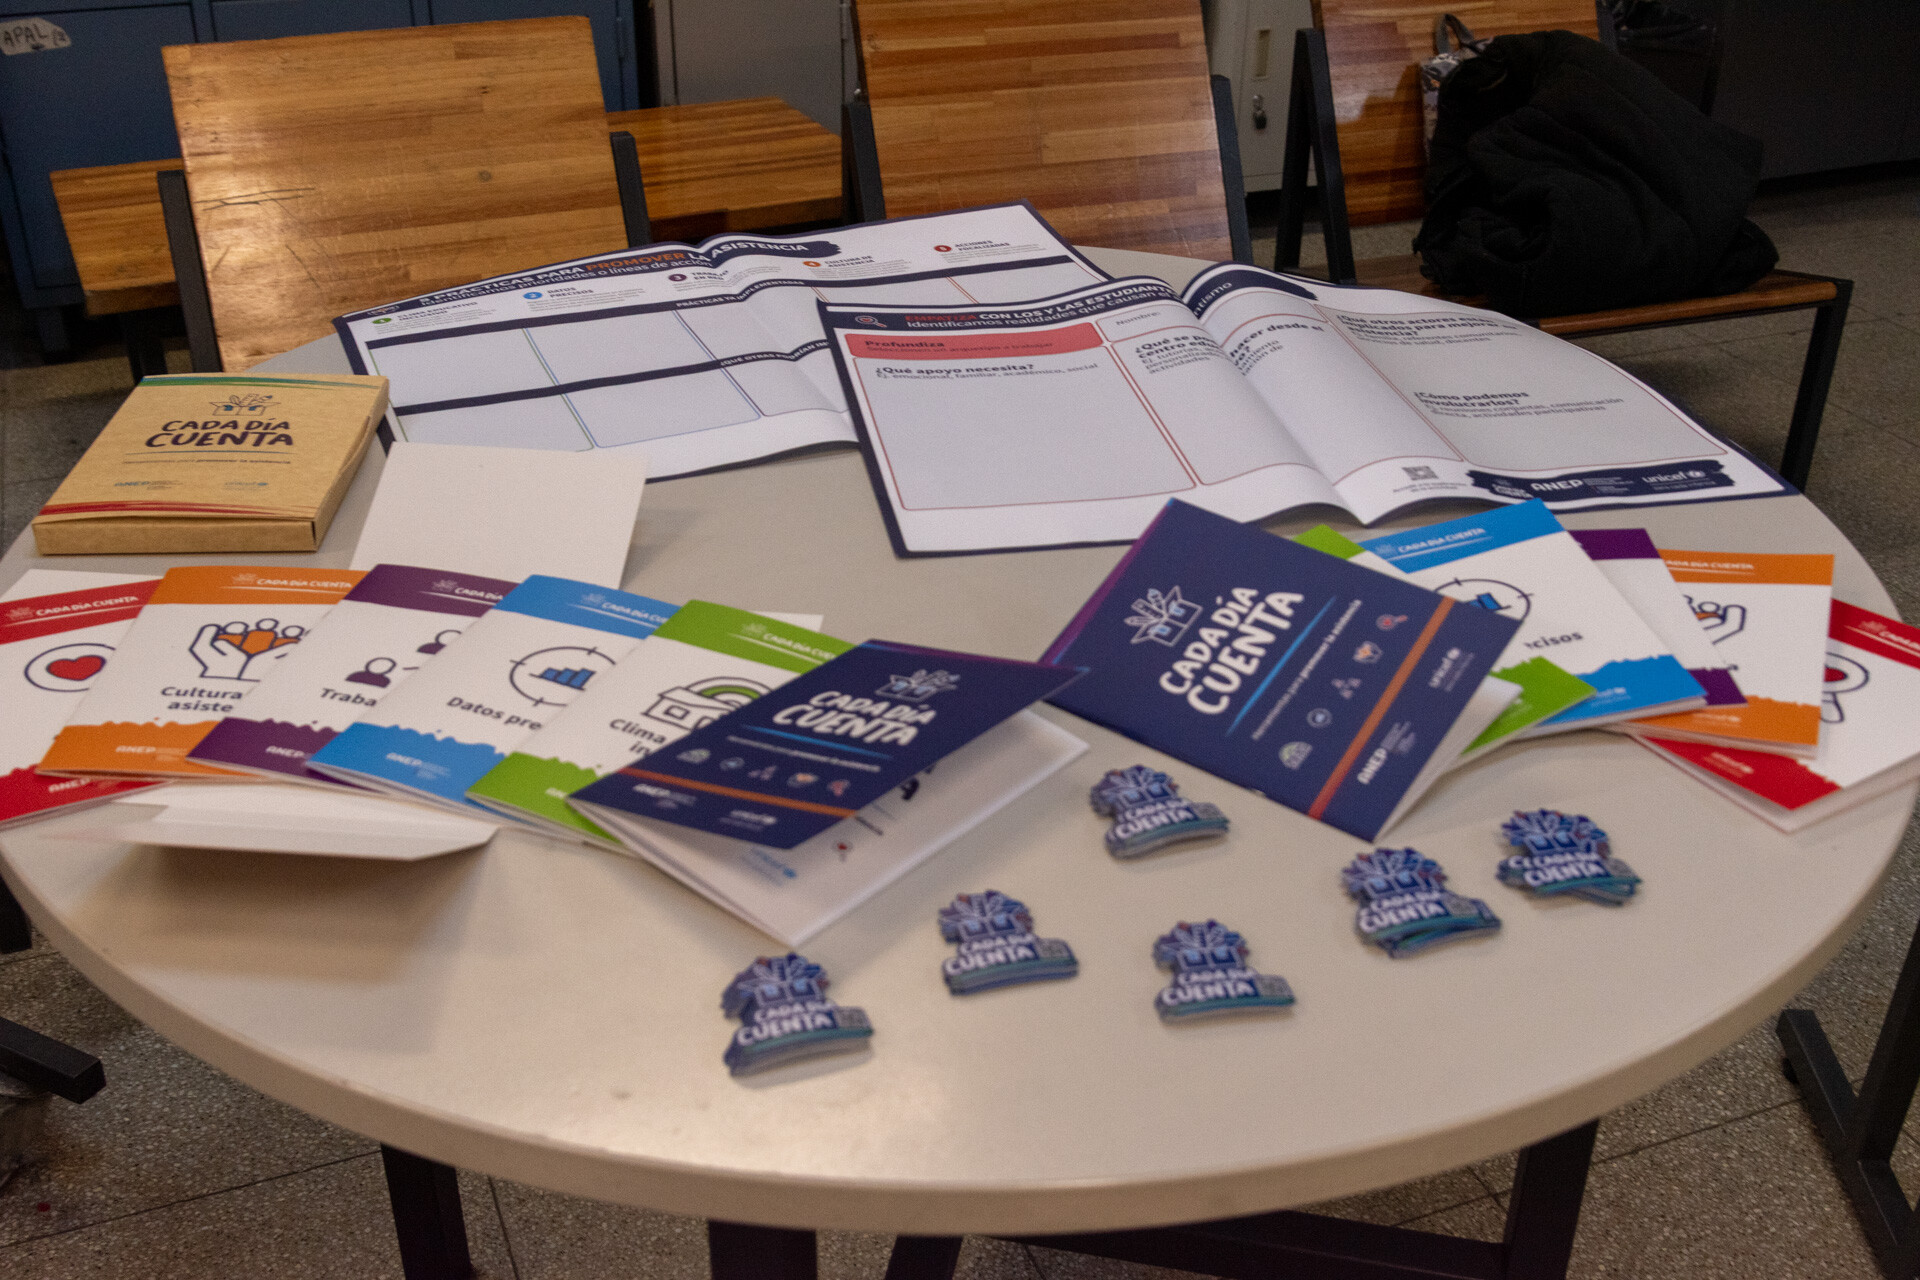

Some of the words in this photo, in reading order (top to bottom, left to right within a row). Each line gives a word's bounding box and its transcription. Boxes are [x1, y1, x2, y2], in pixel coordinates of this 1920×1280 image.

[537, 266, 586, 280] PARA
[586, 252, 686, 271] PROMOVER
[688, 252, 712, 263] LA
[712, 241, 809, 259] ASISTENCIA
[519, 271, 596, 289] prioridades
[609, 262, 649, 275] líneas
[651, 260, 668, 269] de
[905, 314, 978, 322] EMPATIZA
[979, 312, 1010, 320] CON
[1014, 307, 1044, 318] LOS
[1055, 302, 1086, 313] LAS
[907, 319, 1002, 329] Identificamos
[1007, 308, 1078, 325] realidades
[1079, 303, 1107, 315] que
[1108, 291, 1157, 307] causan
[1267, 322, 1309, 332] desde
[865, 340, 945, 348] Profundiza
[1173, 334, 1190, 342] se
[875, 366, 912, 376] ¿Qué
[916, 367, 963, 376] apoyo
[966, 363, 1035, 374] necesita?
[1066, 362, 1099, 373] social
[1461, 390, 1530, 401] podemos
[162, 420, 240, 432] CADA
[244, 418, 291, 431] DÍA
[145, 431, 294, 448] CUENTA
[1531, 479, 1584, 492] ANEP
[1642, 471, 1687, 484] unicef
[309, 580, 353, 588] CUENTA
[36, 605, 71, 617] CADA
[92, 596, 139, 608] CUENTA
[1159, 626, 1230, 695] CADA
[1210, 587, 1260, 629] DÍA
[1186, 591, 1305, 715] CUENTA
[160, 686, 244, 701] Cultura
[319, 687, 378, 708] Traba
[166, 699, 235, 713] asiste
[446, 696, 505, 719] Datos
[503, 714, 543, 732] pre
[809, 690, 891, 717] CADA
[882, 704, 937, 725] DÍA
[609, 718, 668, 744] Clima
[772, 703, 919, 746] CUENTA
[48, 777, 91, 794] ANEP
[1114, 808, 1195, 839] CUENTA
[1523, 860, 1607, 888] CUENTA
[1359, 901, 1447, 933] CUENTA
[944, 944, 1035, 976] CUENTA
[1161, 979, 1256, 1007] CUENTA
[736, 1011, 833, 1047] CUENTA
